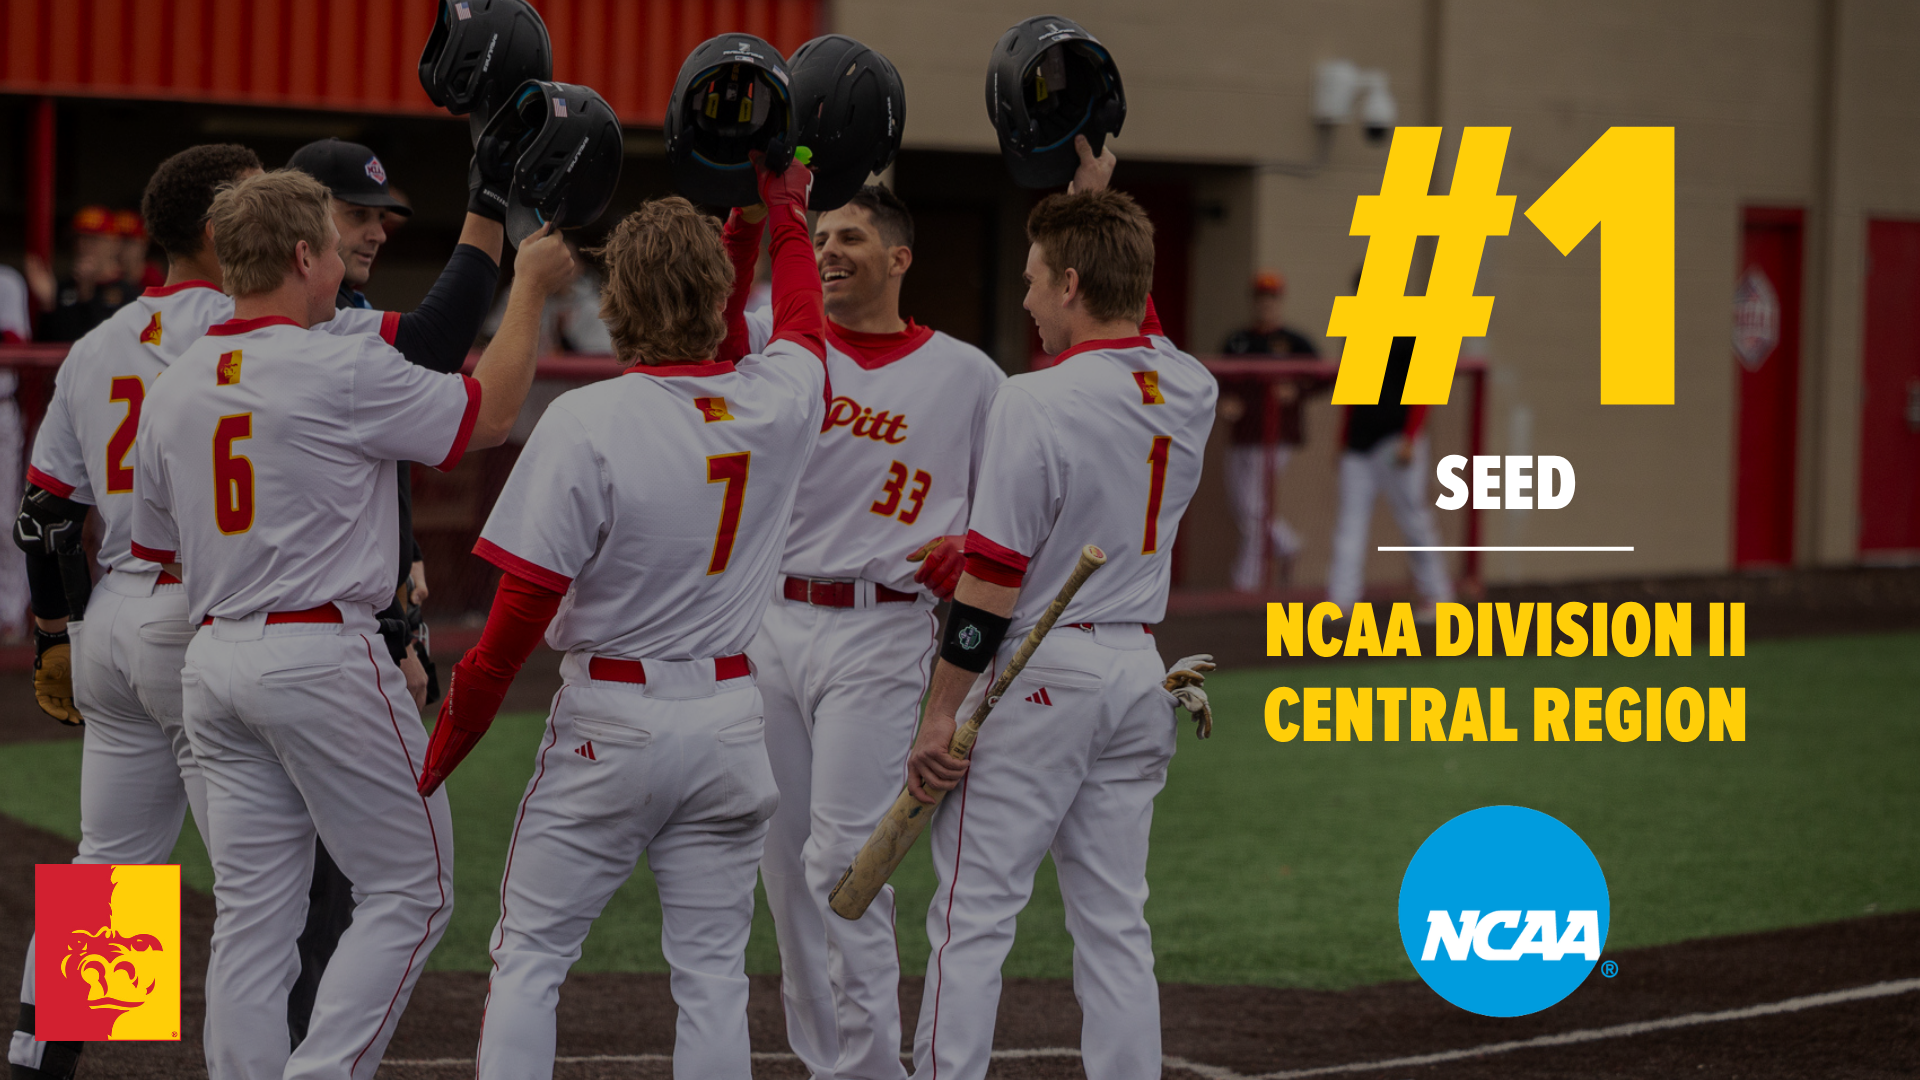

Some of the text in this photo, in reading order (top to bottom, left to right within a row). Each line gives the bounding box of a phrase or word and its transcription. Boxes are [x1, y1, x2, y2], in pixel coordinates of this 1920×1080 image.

[212, 412, 255, 536] 6
[820, 396, 908, 444] Pitt
[706, 451, 750, 576] 7
[870, 460, 932, 526] 33
[1141, 435, 1172, 555] 1
